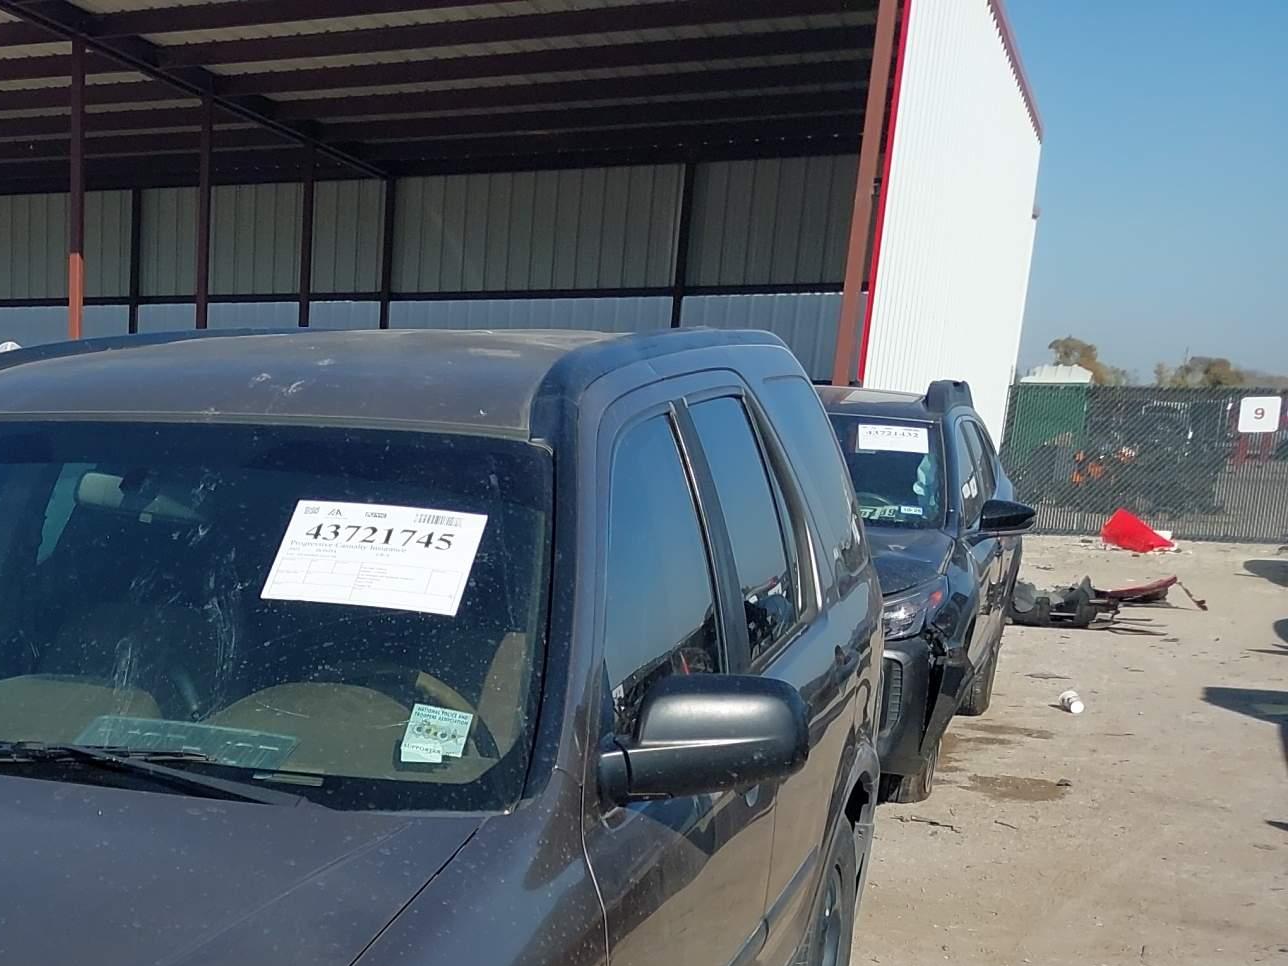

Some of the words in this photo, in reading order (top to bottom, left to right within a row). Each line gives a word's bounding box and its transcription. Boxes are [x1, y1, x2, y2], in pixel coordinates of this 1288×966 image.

[1254, 408, 1265, 420] 9
[305, 523, 456, 551] 43721745
[289, 539, 333, 550] Progressive
[442, 710, 458, 718] POLICE
